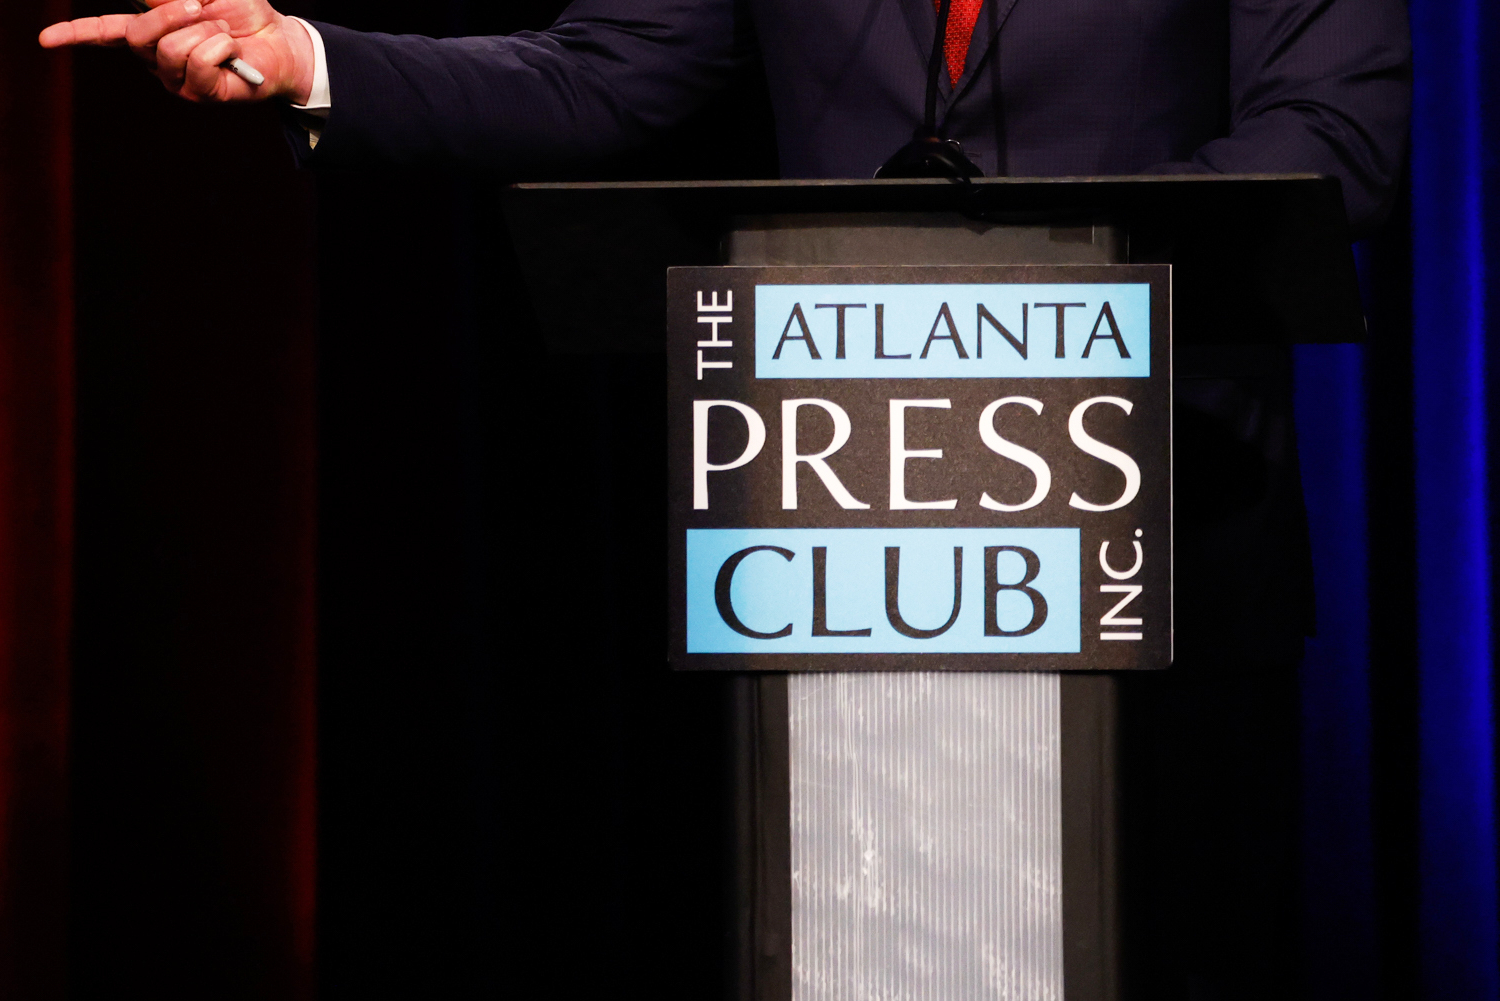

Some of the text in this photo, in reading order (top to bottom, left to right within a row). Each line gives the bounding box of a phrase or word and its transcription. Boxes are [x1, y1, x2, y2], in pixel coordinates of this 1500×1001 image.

[697, 290, 733, 381] THE
[772, 301, 1132, 360] ATLANTA
[693, 396, 1141, 512] PRESS
[714, 545, 1049, 639] CLUB
[1099, 528, 1143, 641] INC.
